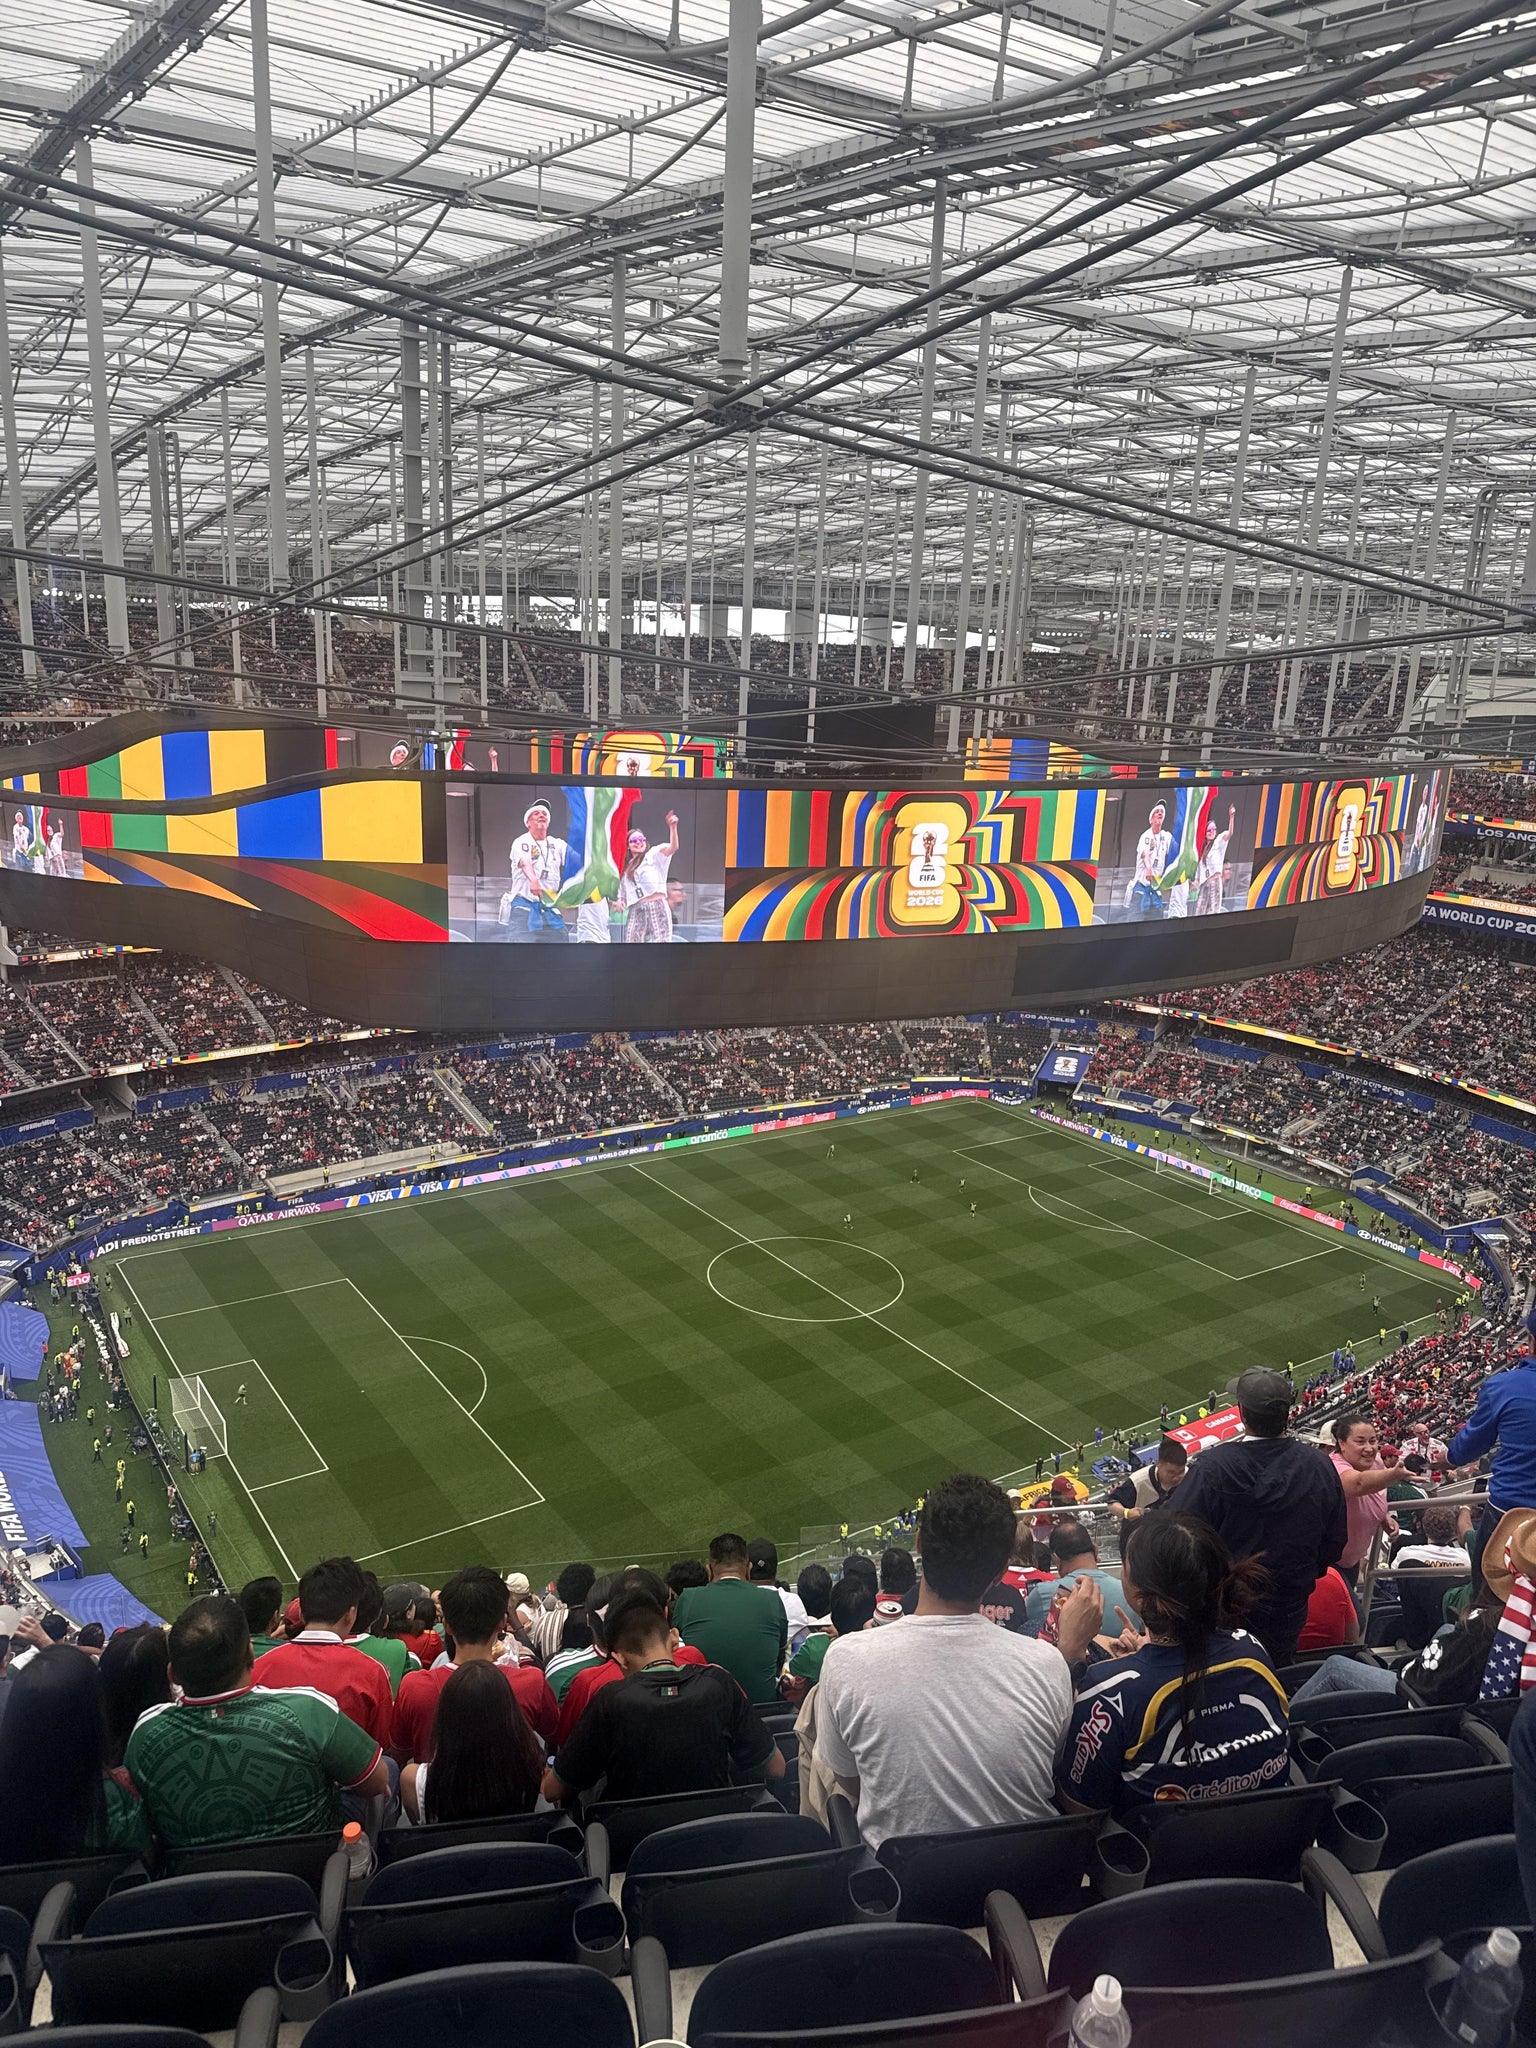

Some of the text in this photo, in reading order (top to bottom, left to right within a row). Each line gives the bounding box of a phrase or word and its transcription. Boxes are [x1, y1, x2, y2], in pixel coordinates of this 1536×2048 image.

[1477, 828, 1504, 838] LOS
[919, 874, 936, 882] FIFA
[907, 895, 944, 907] 2026
[1471, 898, 1484, 906] FIFA
[1485, 901, 1506, 909] WORLD
[1506, 904, 1519, 912] CUP
[1439, 908, 1486, 926] WORLD
[1487, 916, 1514, 930] CUP
[1038, 1015, 1076, 1024] ANGELES
[290, 1071, 307, 1080] FIFA
[335, 1064, 351, 1073] CUP
[922, 1093, 943, 1103] Lenovo
[1040, 1110, 1089, 1135] QATAR AIRWAYS
[690, 1129, 728, 1144] aramco
[1110, 1134, 1128, 1148] VISA
[585, 1154, 598, 1162] FIFA
[598, 1152, 618, 1161] WORLD
[618, 1149, 629, 1157] CUP
[420, 1181, 443, 1194] VISA
[1221, 1176, 1262, 1198] aramco
[287, 1197, 304, 1206] FIFA
[368, 1190, 394, 1204] VISA
[238, 1203, 321, 1227] QATAR AIRWAYS
[97, 1226, 202, 1257] ADI PREDICTSTREET
[1371, 1234, 1406, 1254] HYUNDAI
[1204, 1413, 1238, 1429] CANADA
[0, 1513, 29, 1542] FIFA
[1201, 1701, 1235, 1717] PIRMA
[1187, 1774, 1252, 1801] Crédito
